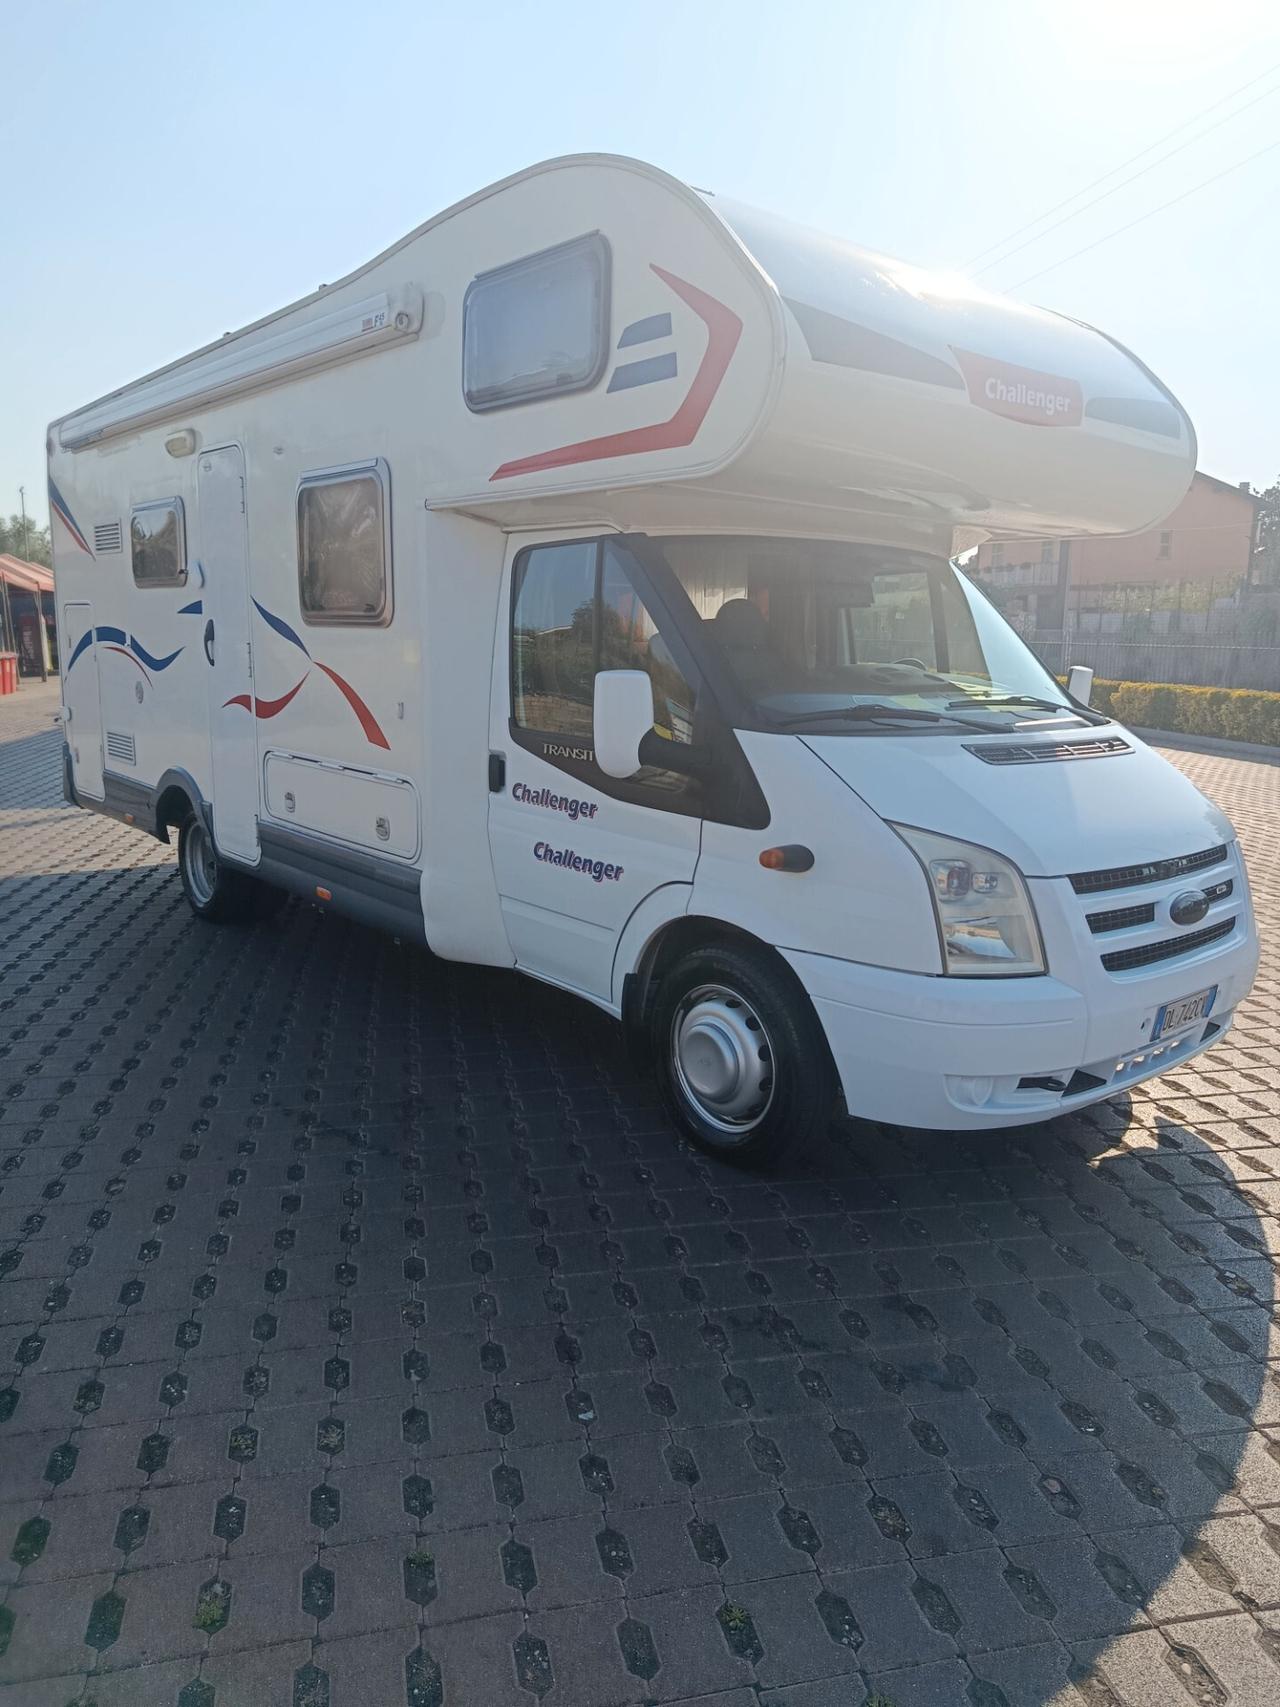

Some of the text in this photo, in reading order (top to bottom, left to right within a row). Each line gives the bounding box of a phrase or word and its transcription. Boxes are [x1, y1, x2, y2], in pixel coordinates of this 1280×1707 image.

[984, 377, 1072, 416] Challenger
[543, 743, 594, 762] TRANSIT
[512, 782, 599, 821] Challenger
[533, 841, 624, 883] Challenger
